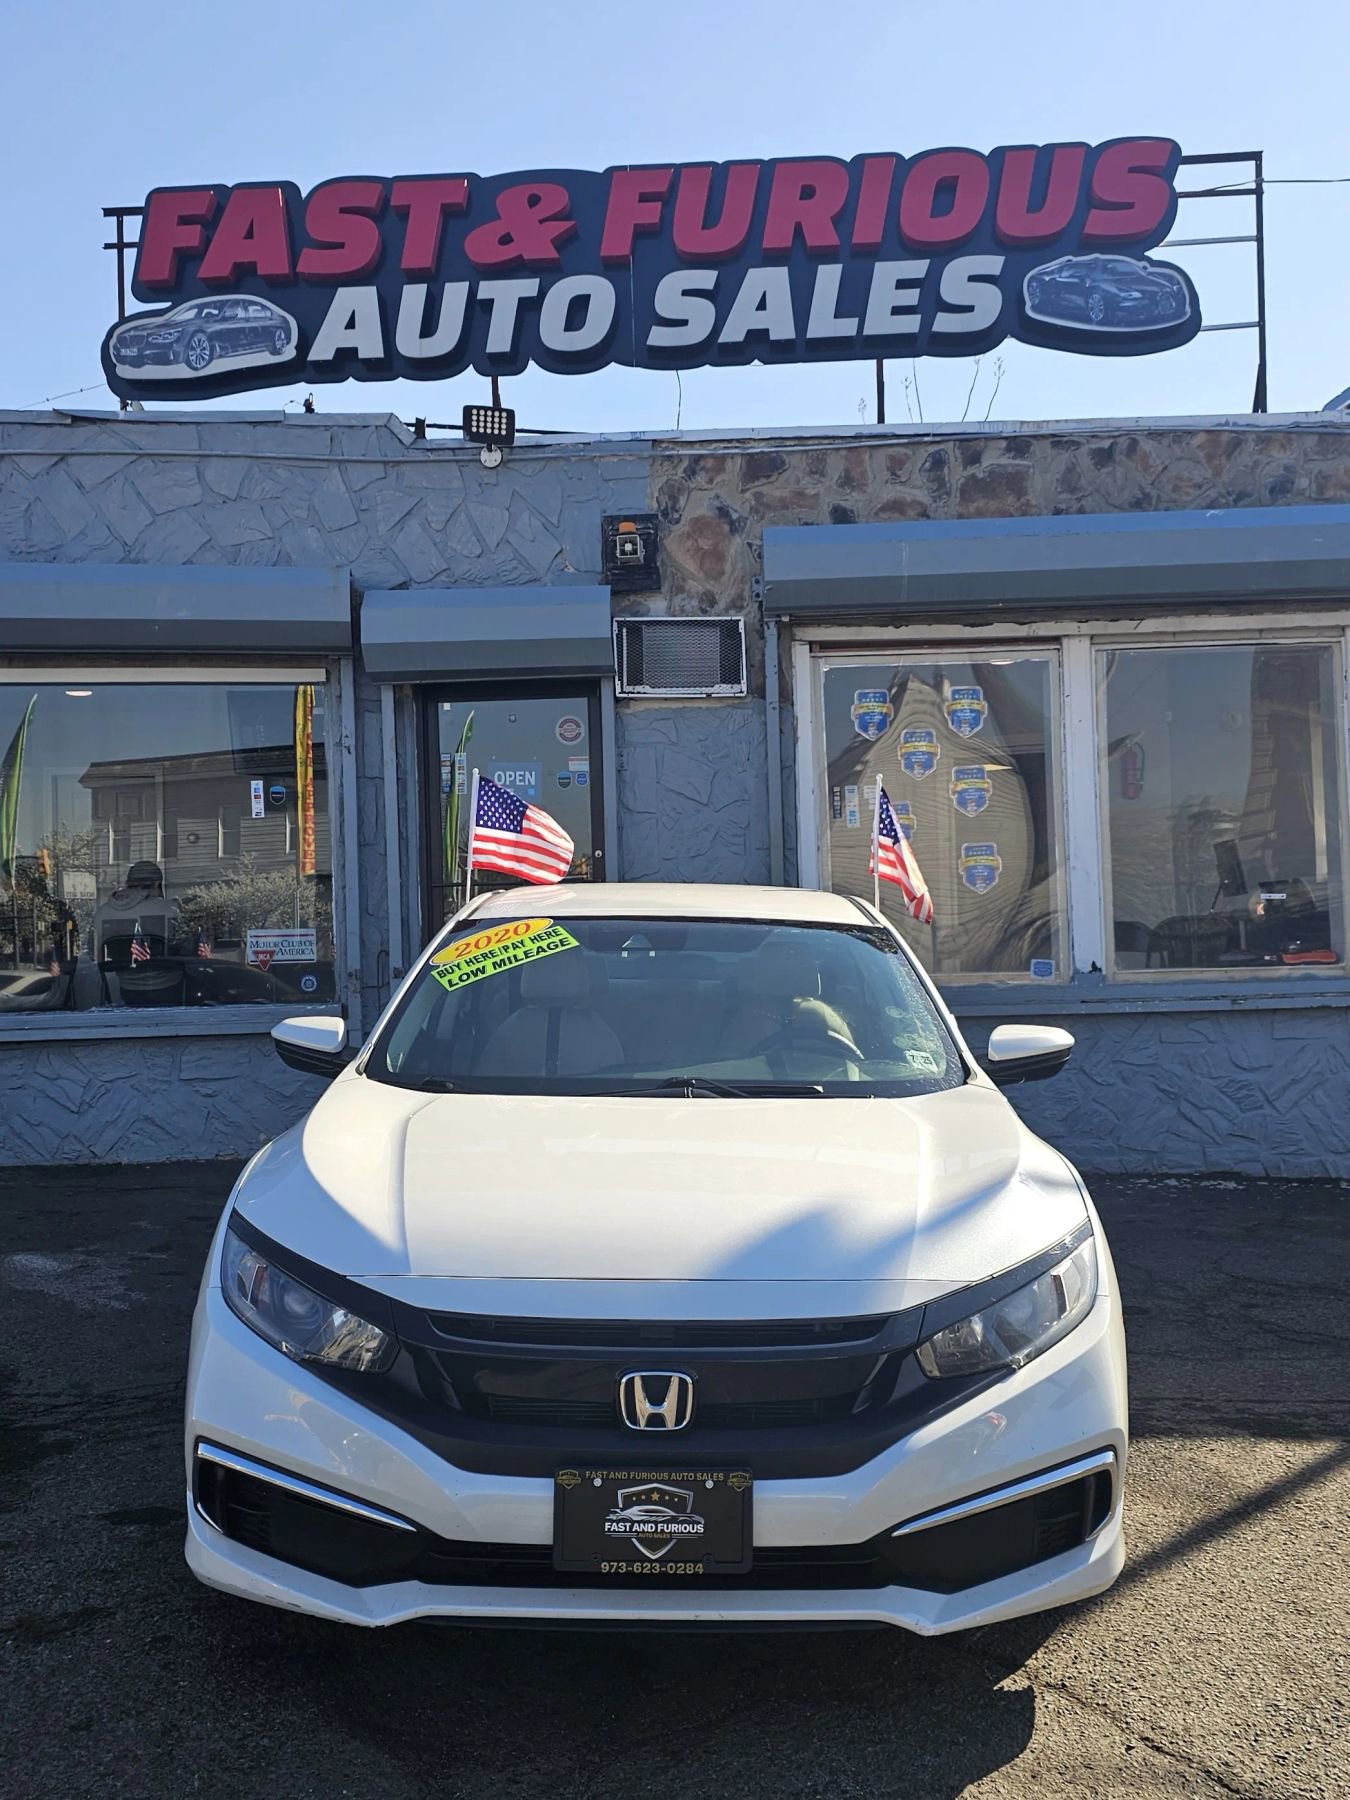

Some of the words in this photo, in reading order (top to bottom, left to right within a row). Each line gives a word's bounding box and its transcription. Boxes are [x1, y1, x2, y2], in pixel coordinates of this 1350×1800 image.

[138, 178, 470, 288] FAST
[464, 183, 577, 271] &
[599, 139, 1174, 263] FURIOUS
[306, 274, 616, 362] AUTO
[646, 255, 1006, 348] SALES
[494, 771, 536, 786] OPEN
[249, 940, 280, 949] MOTOR
[280, 939, 303, 948] CLUB
[455, 922, 531, 959] 2020
[276, 947, 315, 956] AMERICA
[436, 963, 461, 979] BUY
[528, 927, 563, 945] HERE
[447, 965, 487, 988] LOW
[492, 937, 572, 971] MILEAGE
[585, 1471, 609, 1480] FAST
[609, 1471, 628, 1480] AND
[630, 1472, 669, 1481] FURIOUS
[670, 1472, 695, 1481] AUTO
[696, 1472, 724, 1481] SALES
[604, 1522, 631, 1532] FAST
[632, 1523, 655, 1532] AND
[657, 1523, 704, 1533] FURIOUS
[600, 1562, 704, 1574] 973-623-0284
